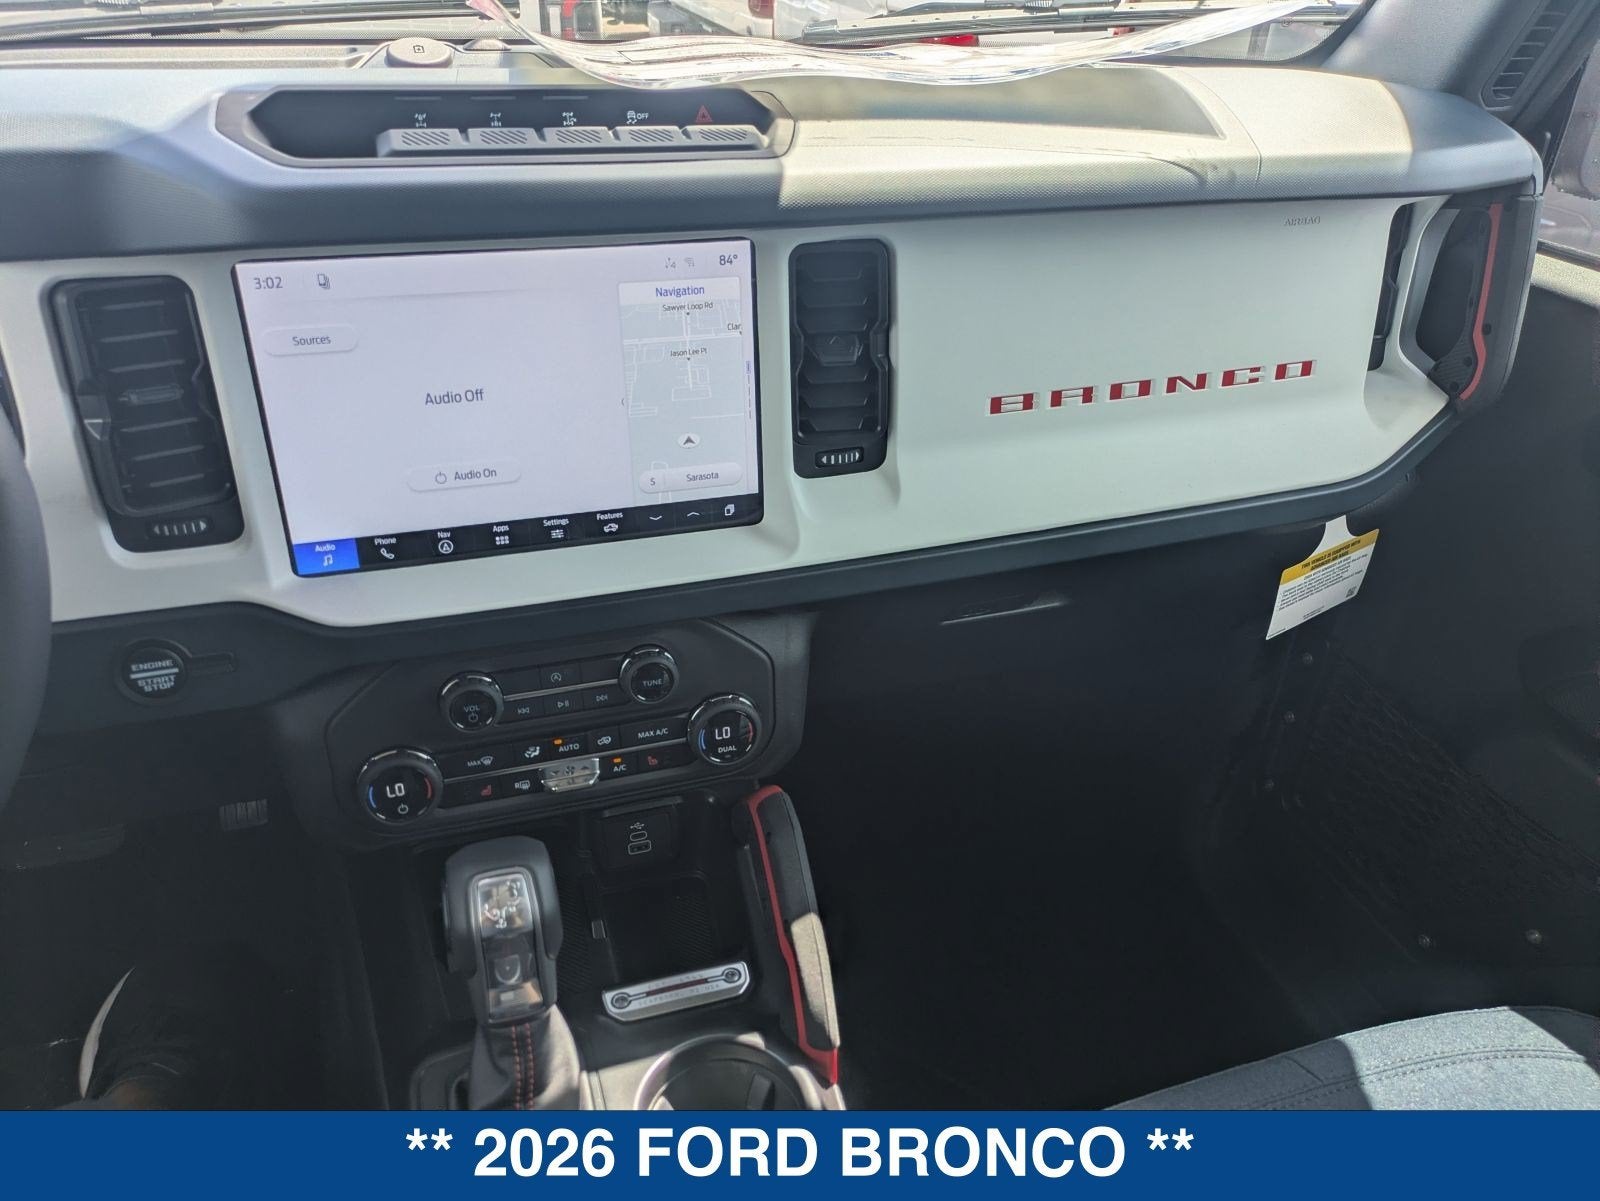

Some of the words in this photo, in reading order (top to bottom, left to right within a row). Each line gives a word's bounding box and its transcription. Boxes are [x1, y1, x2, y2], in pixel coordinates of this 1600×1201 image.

[636, 112, 649, 120] OFF
[253, 276, 283, 290] 3:02
[655, 285, 705, 298] Navigation
[662, 304, 686, 313] Sawyer
[687, 303, 703, 312] Loop
[704, 301, 714, 309] Rd
[292, 334, 331, 347] Sources
[670, 349, 688, 358] Jason
[688, 348, 700, 356] Lee
[986, 359, 1317, 416] BRONCO
[424, 389, 462, 406] Audio
[465, 388, 485, 403] Off
[454, 469, 482, 481] Audio
[483, 467, 497, 479] On
[686, 471, 719, 482] Sarasota
[596, 512, 624, 521] Features
[543, 518, 570, 527] Settings
[492, 525, 510, 534] Apps
[437, 531, 451, 539] Nav
[374, 536, 397, 546] Phone
[314, 543, 336, 552] Audio
[131, 660, 173, 671] ENGINE
[138, 675, 176, 686] START
[642, 678, 663, 687] TUNE
[144, 682, 175, 692] STOP
[463, 704, 480, 713] VOL
[637, 731, 654, 739] MAX
[655, 727, 669, 736] A/C
[715, 726, 731, 741] LO
[558, 743, 580, 753] AUTO
[718, 745, 737, 754] DUAL
[467, 760, 482, 768] MAX
[613, 764, 627, 773] A/C
[386, 782, 405, 799] LO
